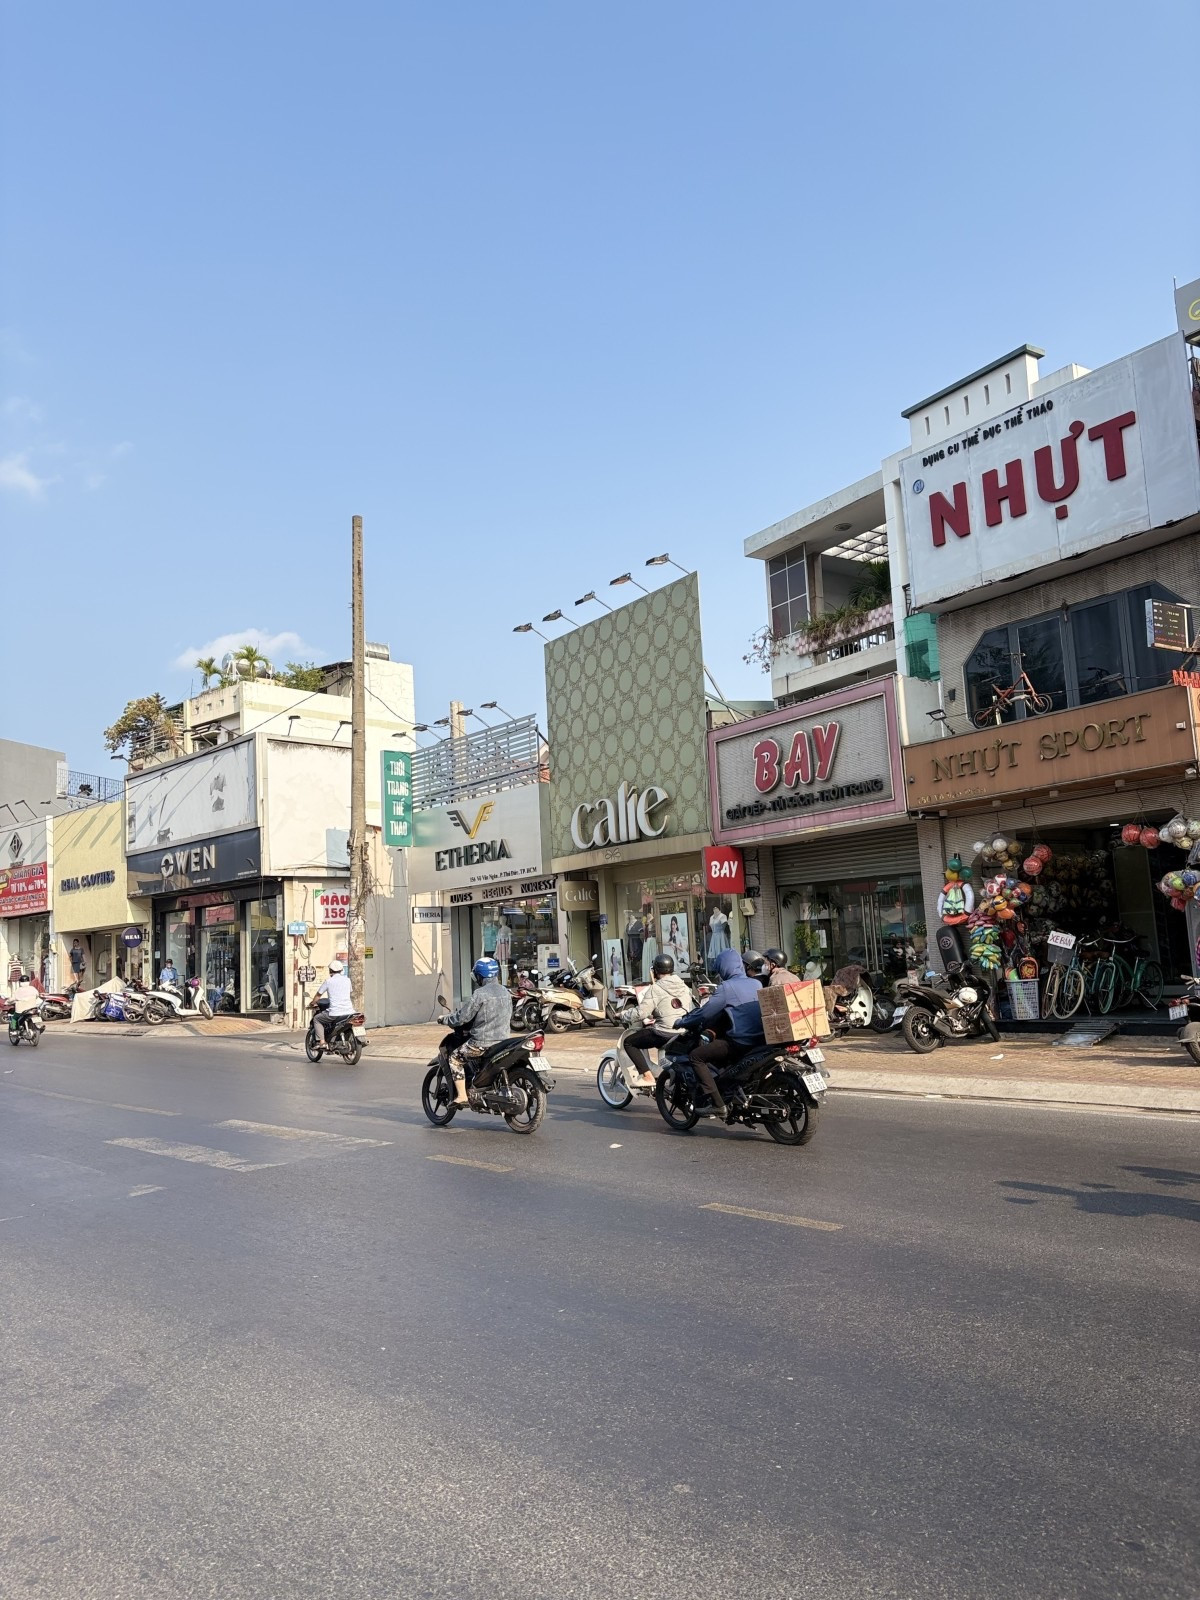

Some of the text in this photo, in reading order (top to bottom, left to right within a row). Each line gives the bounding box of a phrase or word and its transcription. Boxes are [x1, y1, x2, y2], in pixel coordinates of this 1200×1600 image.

[922, 399, 1054, 467] DỤNG CỤ THỂ DỤC THỂ THAO
[928, 410, 1136, 547] NHỰT
[752, 721, 841, 794] BAY
[931, 712, 1151, 782] NHỰT SPORT
[386, 780, 409, 797] TRANG
[843, 778, 883, 797] TRANG
[390, 820, 408, 837] THAO
[161, 844, 216, 878] OWEN
[435, 838, 512, 872] ETHERIA
[710, 860, 739, 878] BAY
[61, 870, 115, 892] REAL CLOTHES
[482, 885, 513, 900] REGIUS
[324, 907, 346, 919] 158
